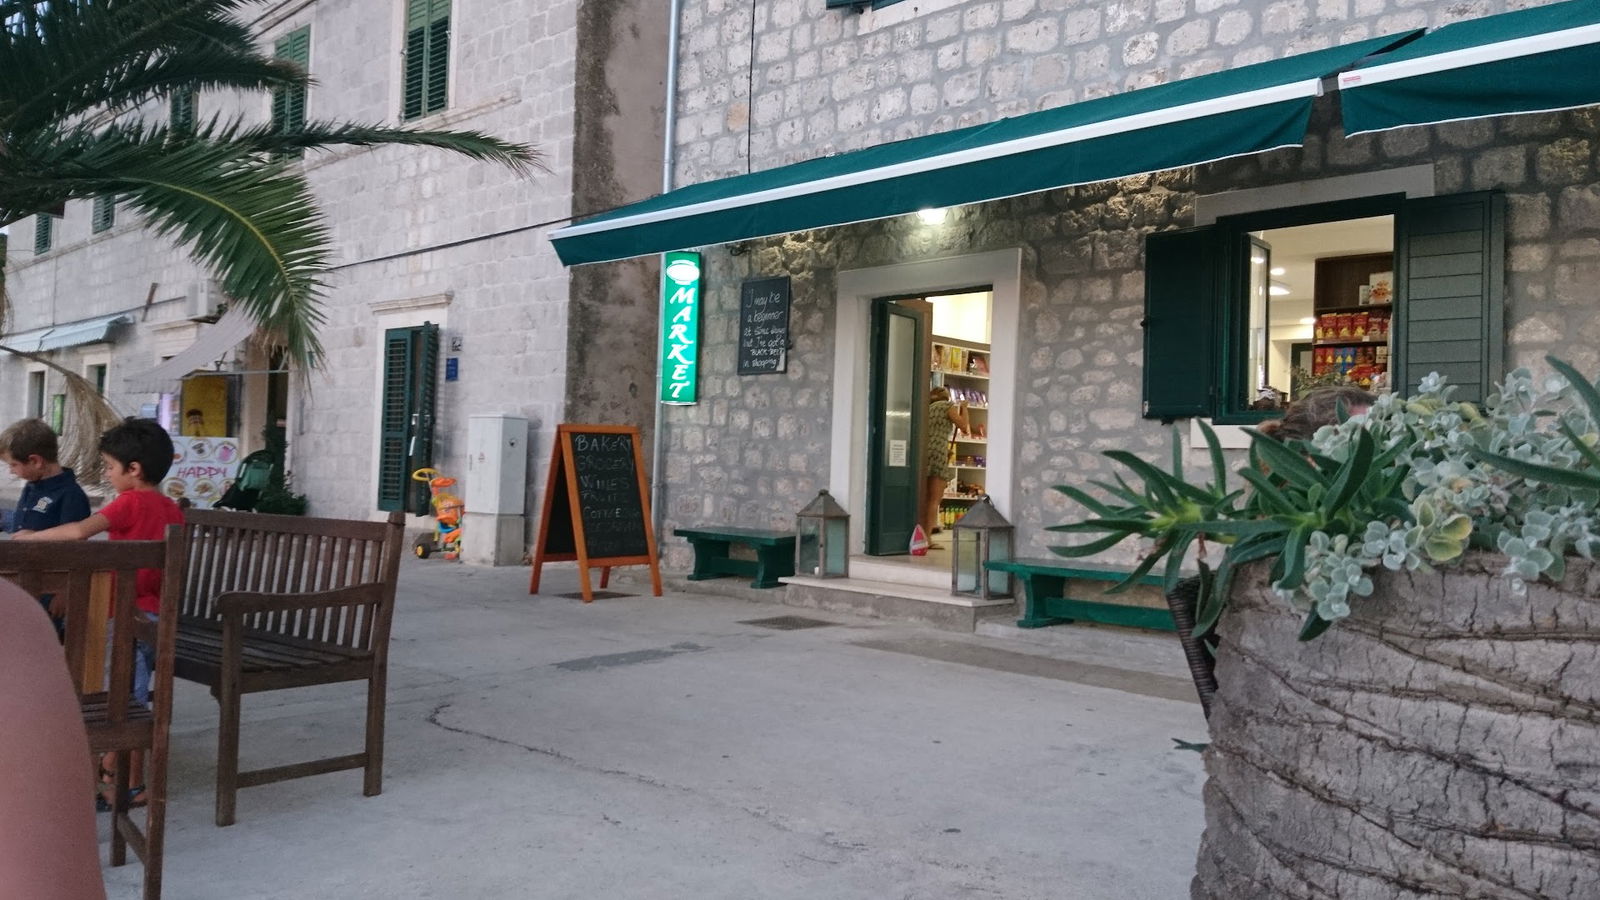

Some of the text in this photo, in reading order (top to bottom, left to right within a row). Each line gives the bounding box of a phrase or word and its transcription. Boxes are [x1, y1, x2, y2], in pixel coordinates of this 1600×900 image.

[667, 287, 696, 398] MARKET
[575, 434, 631, 452] BAKERY
[177, 466, 228, 478] HAPPY
